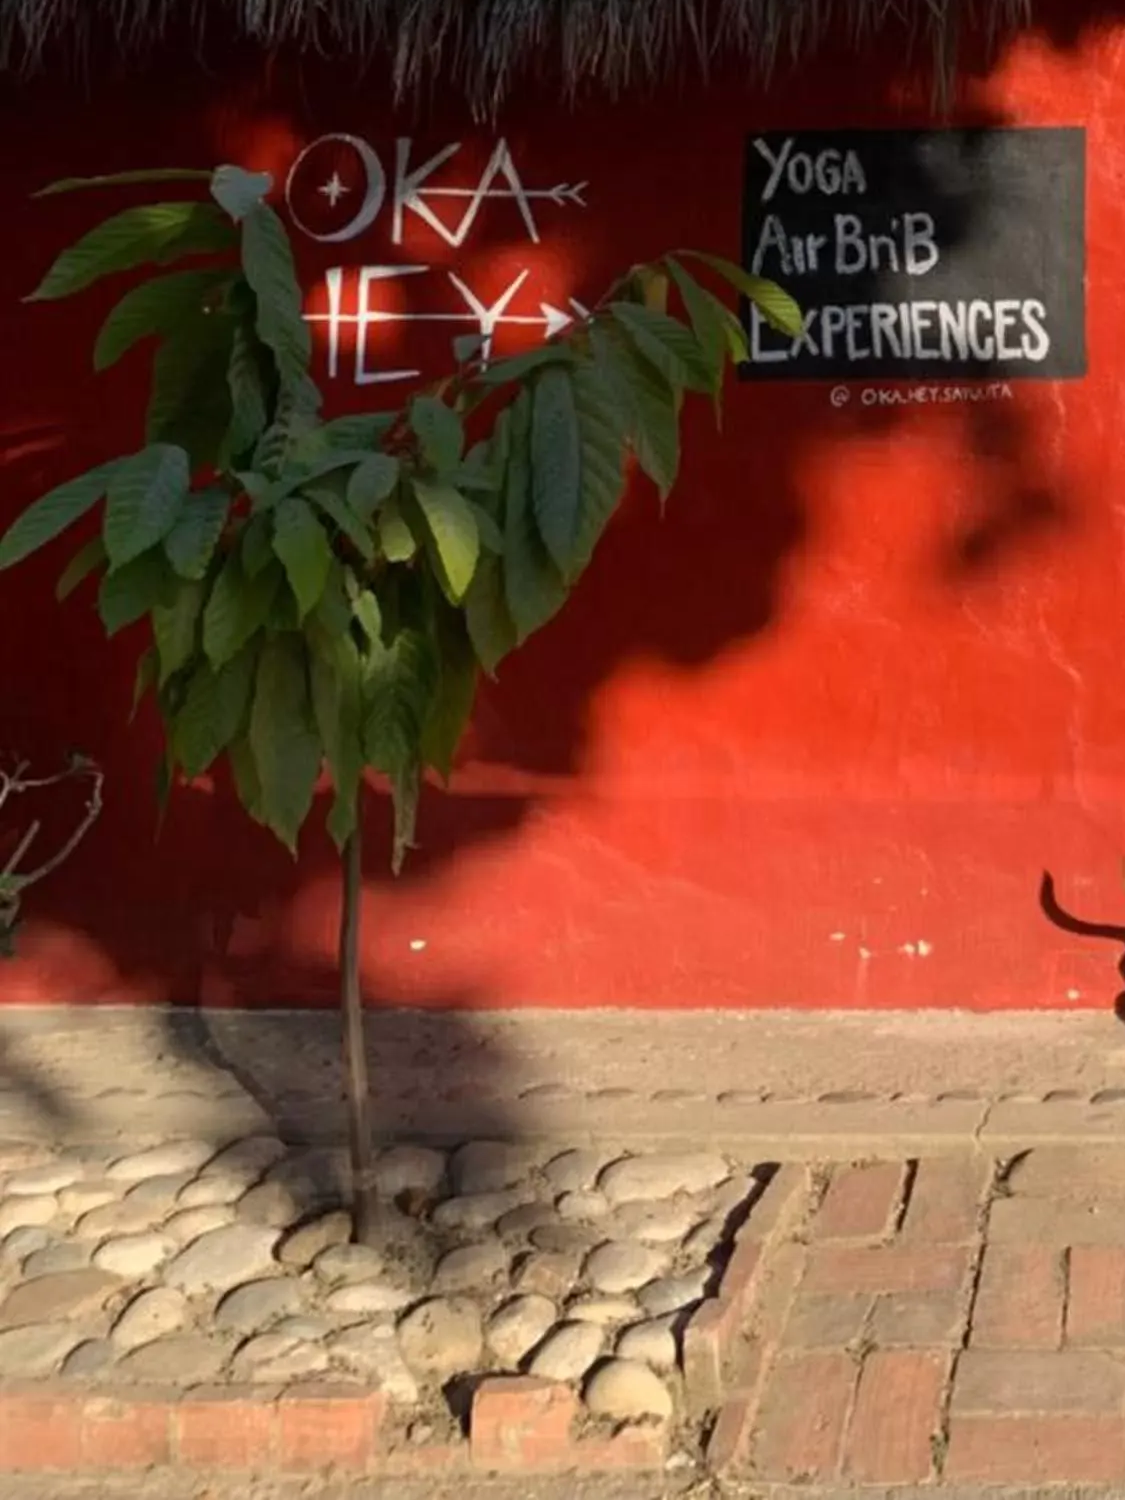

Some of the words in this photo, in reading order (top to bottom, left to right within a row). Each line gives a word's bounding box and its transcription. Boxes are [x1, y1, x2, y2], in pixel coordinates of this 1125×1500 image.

[286, 132, 540, 248] OKA
[753, 138, 867, 201] YOGA
[751, 298, 1050, 363] EXPERIENCES
